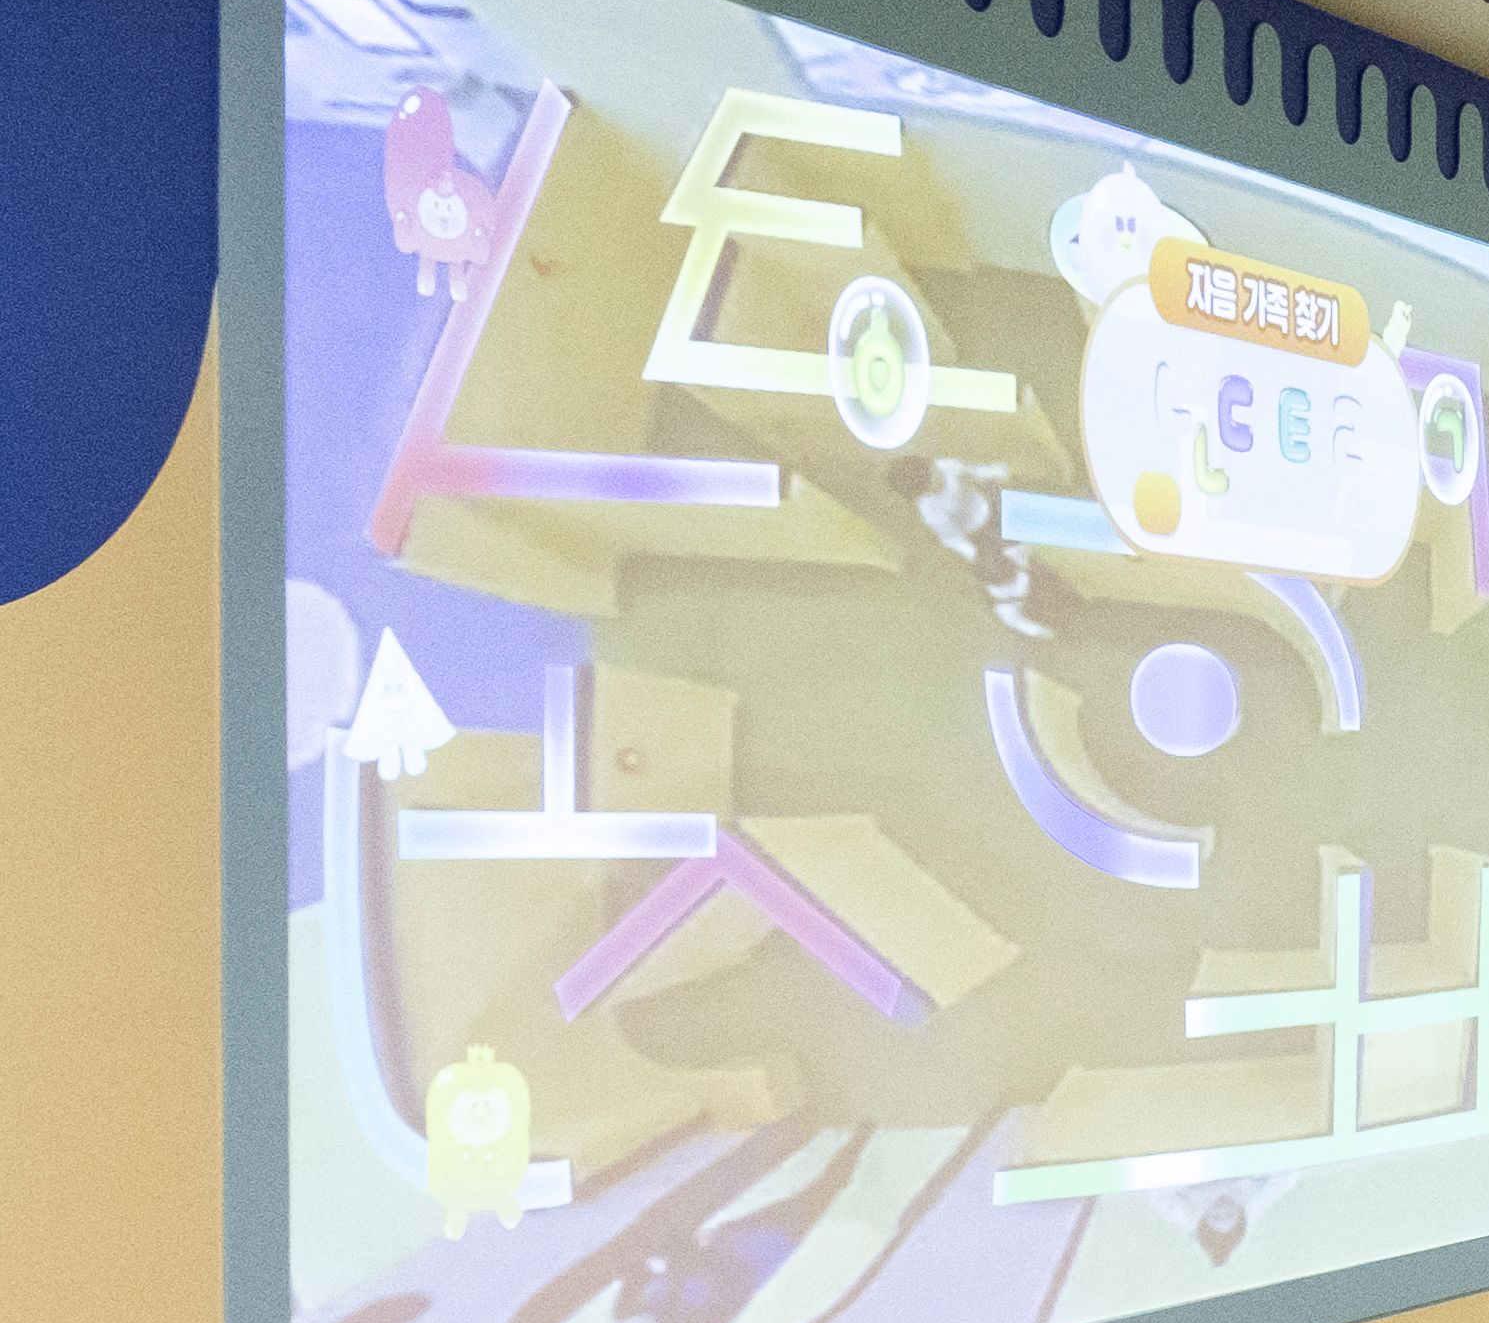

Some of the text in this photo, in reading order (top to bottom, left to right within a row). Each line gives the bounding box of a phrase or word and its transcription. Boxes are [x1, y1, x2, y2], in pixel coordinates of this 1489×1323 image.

[1186, 260, 1339, 346] 자음 가족 찾기
